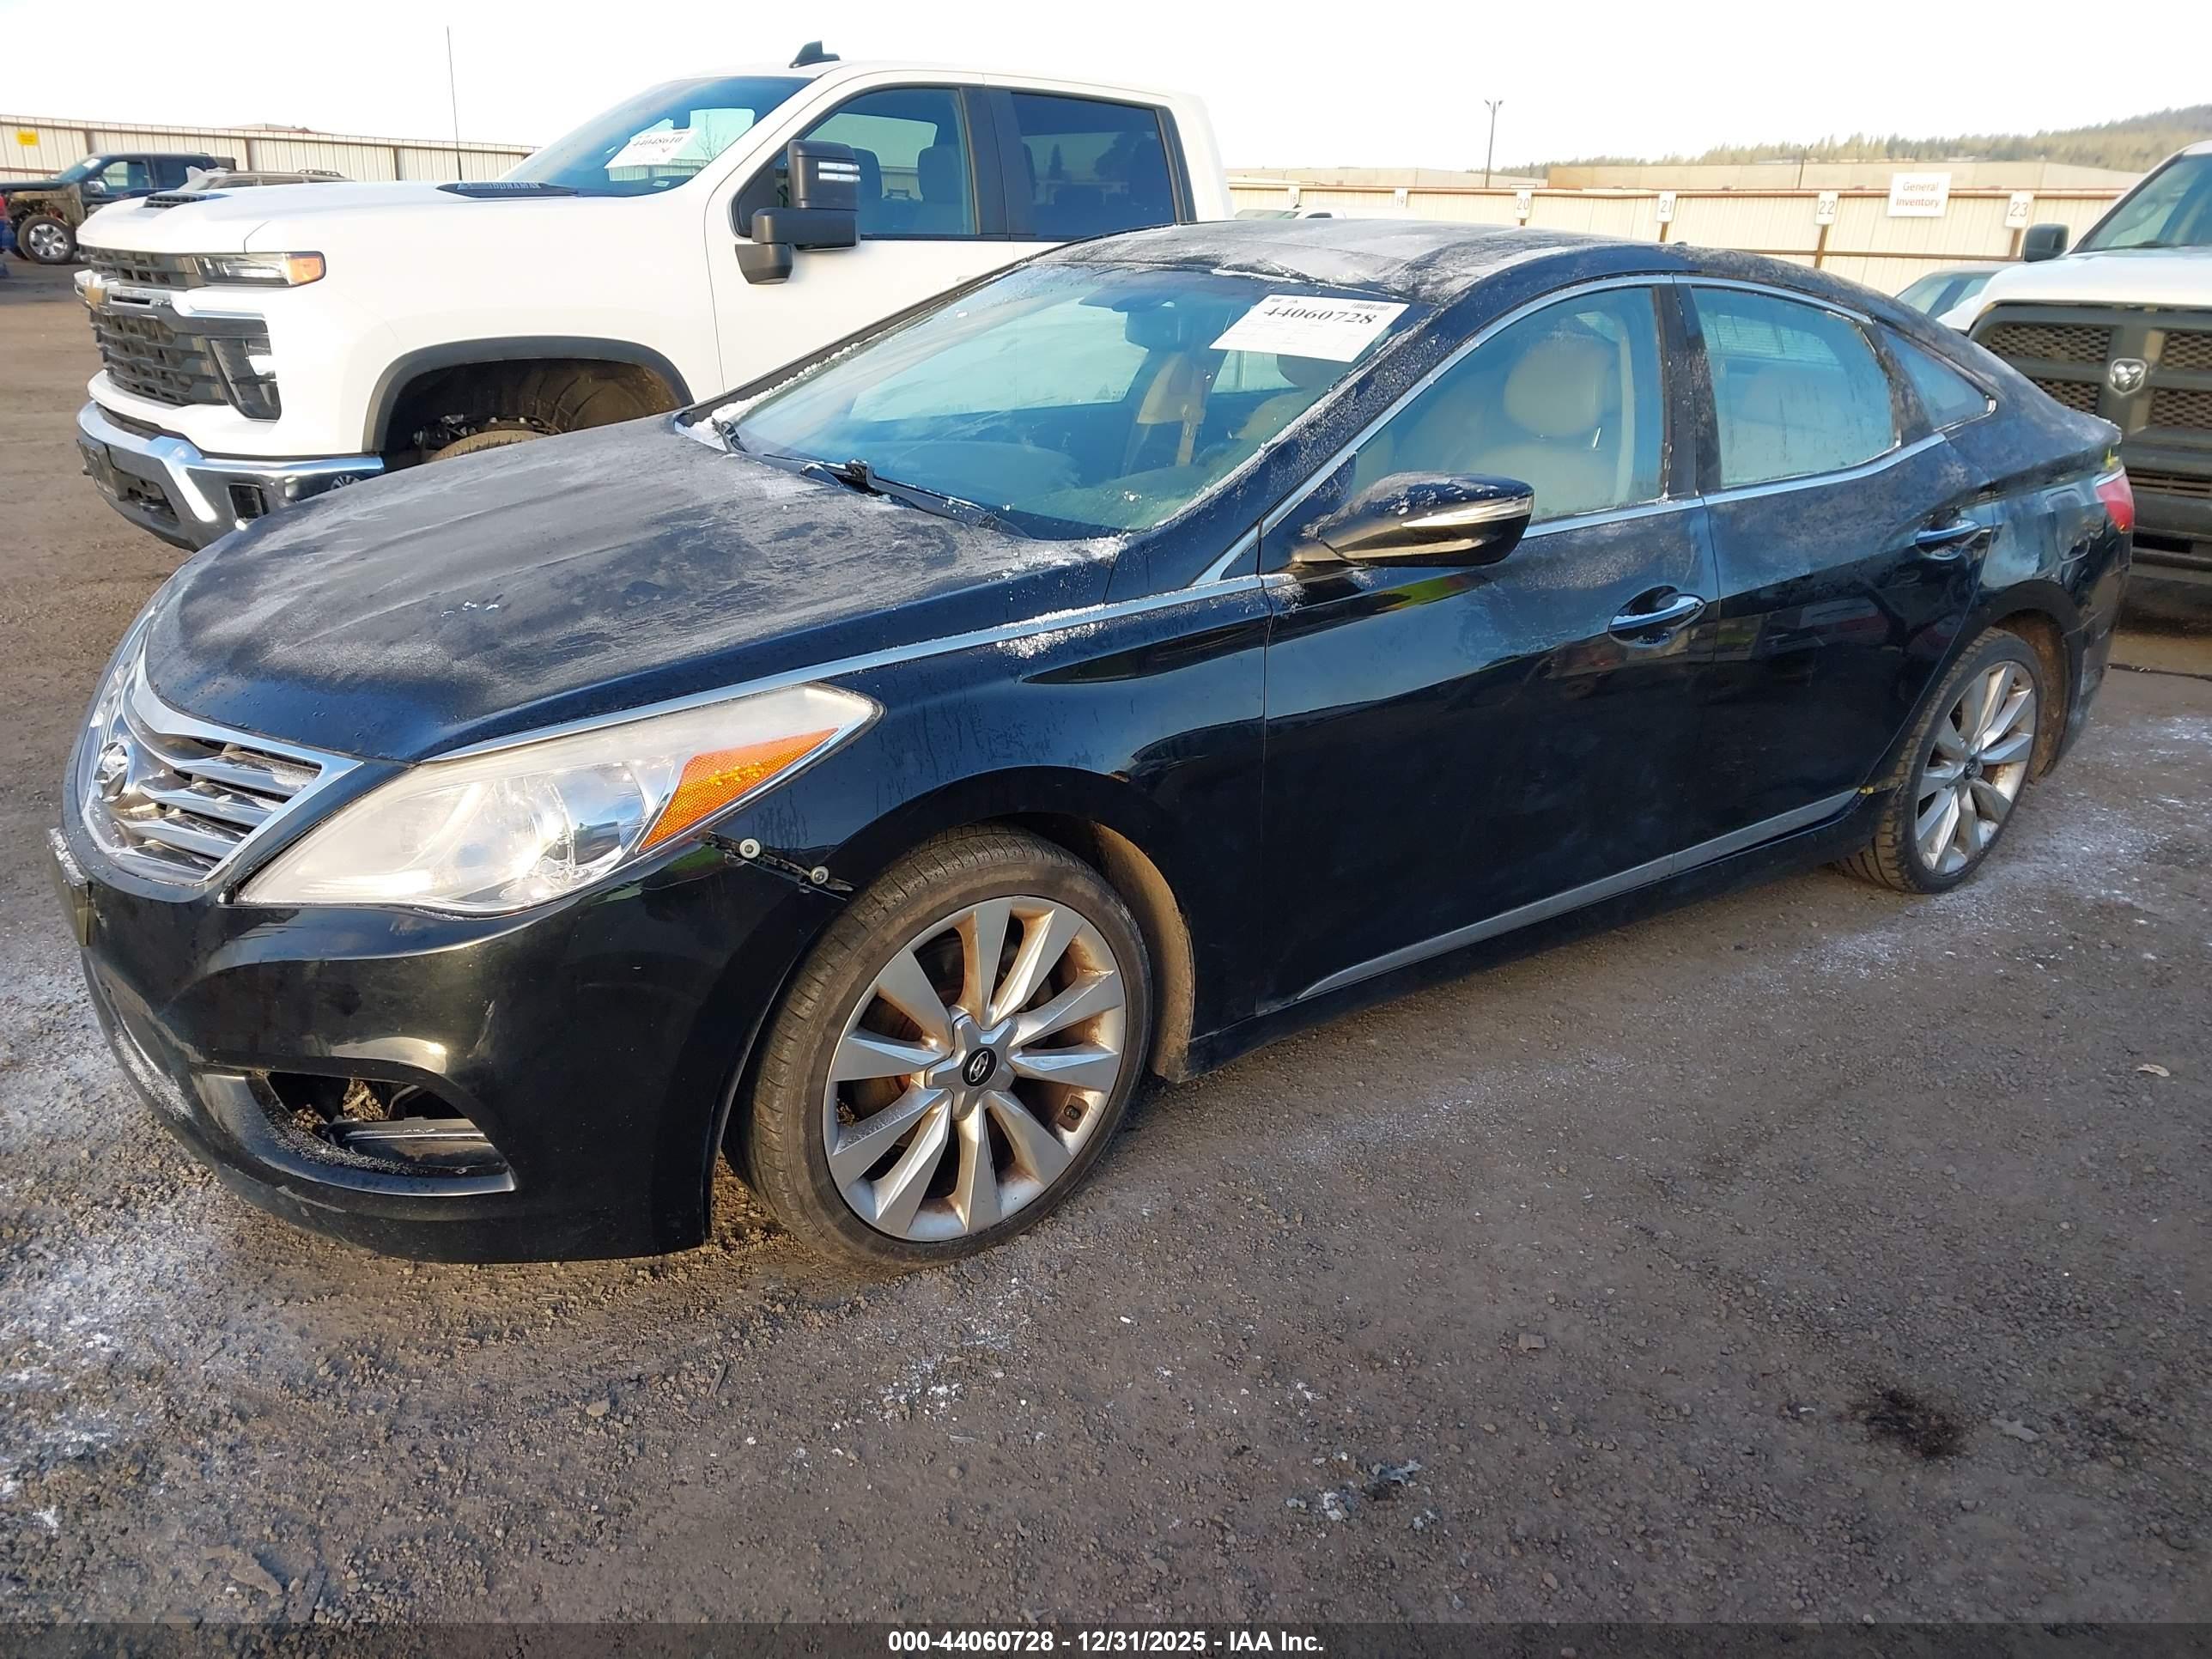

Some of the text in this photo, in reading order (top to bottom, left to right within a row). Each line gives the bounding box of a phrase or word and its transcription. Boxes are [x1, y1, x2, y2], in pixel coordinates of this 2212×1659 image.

[1903, 181, 1939, 191] General
[1516, 198, 1529, 210] 20
[1660, 200, 1673, 213] 21
[1818, 201, 1835, 215] 22
[1896, 198, 1941, 209] Inventory
[2009, 202, 2029, 217] 23
[1263, 307, 1377, 325] 44060728
